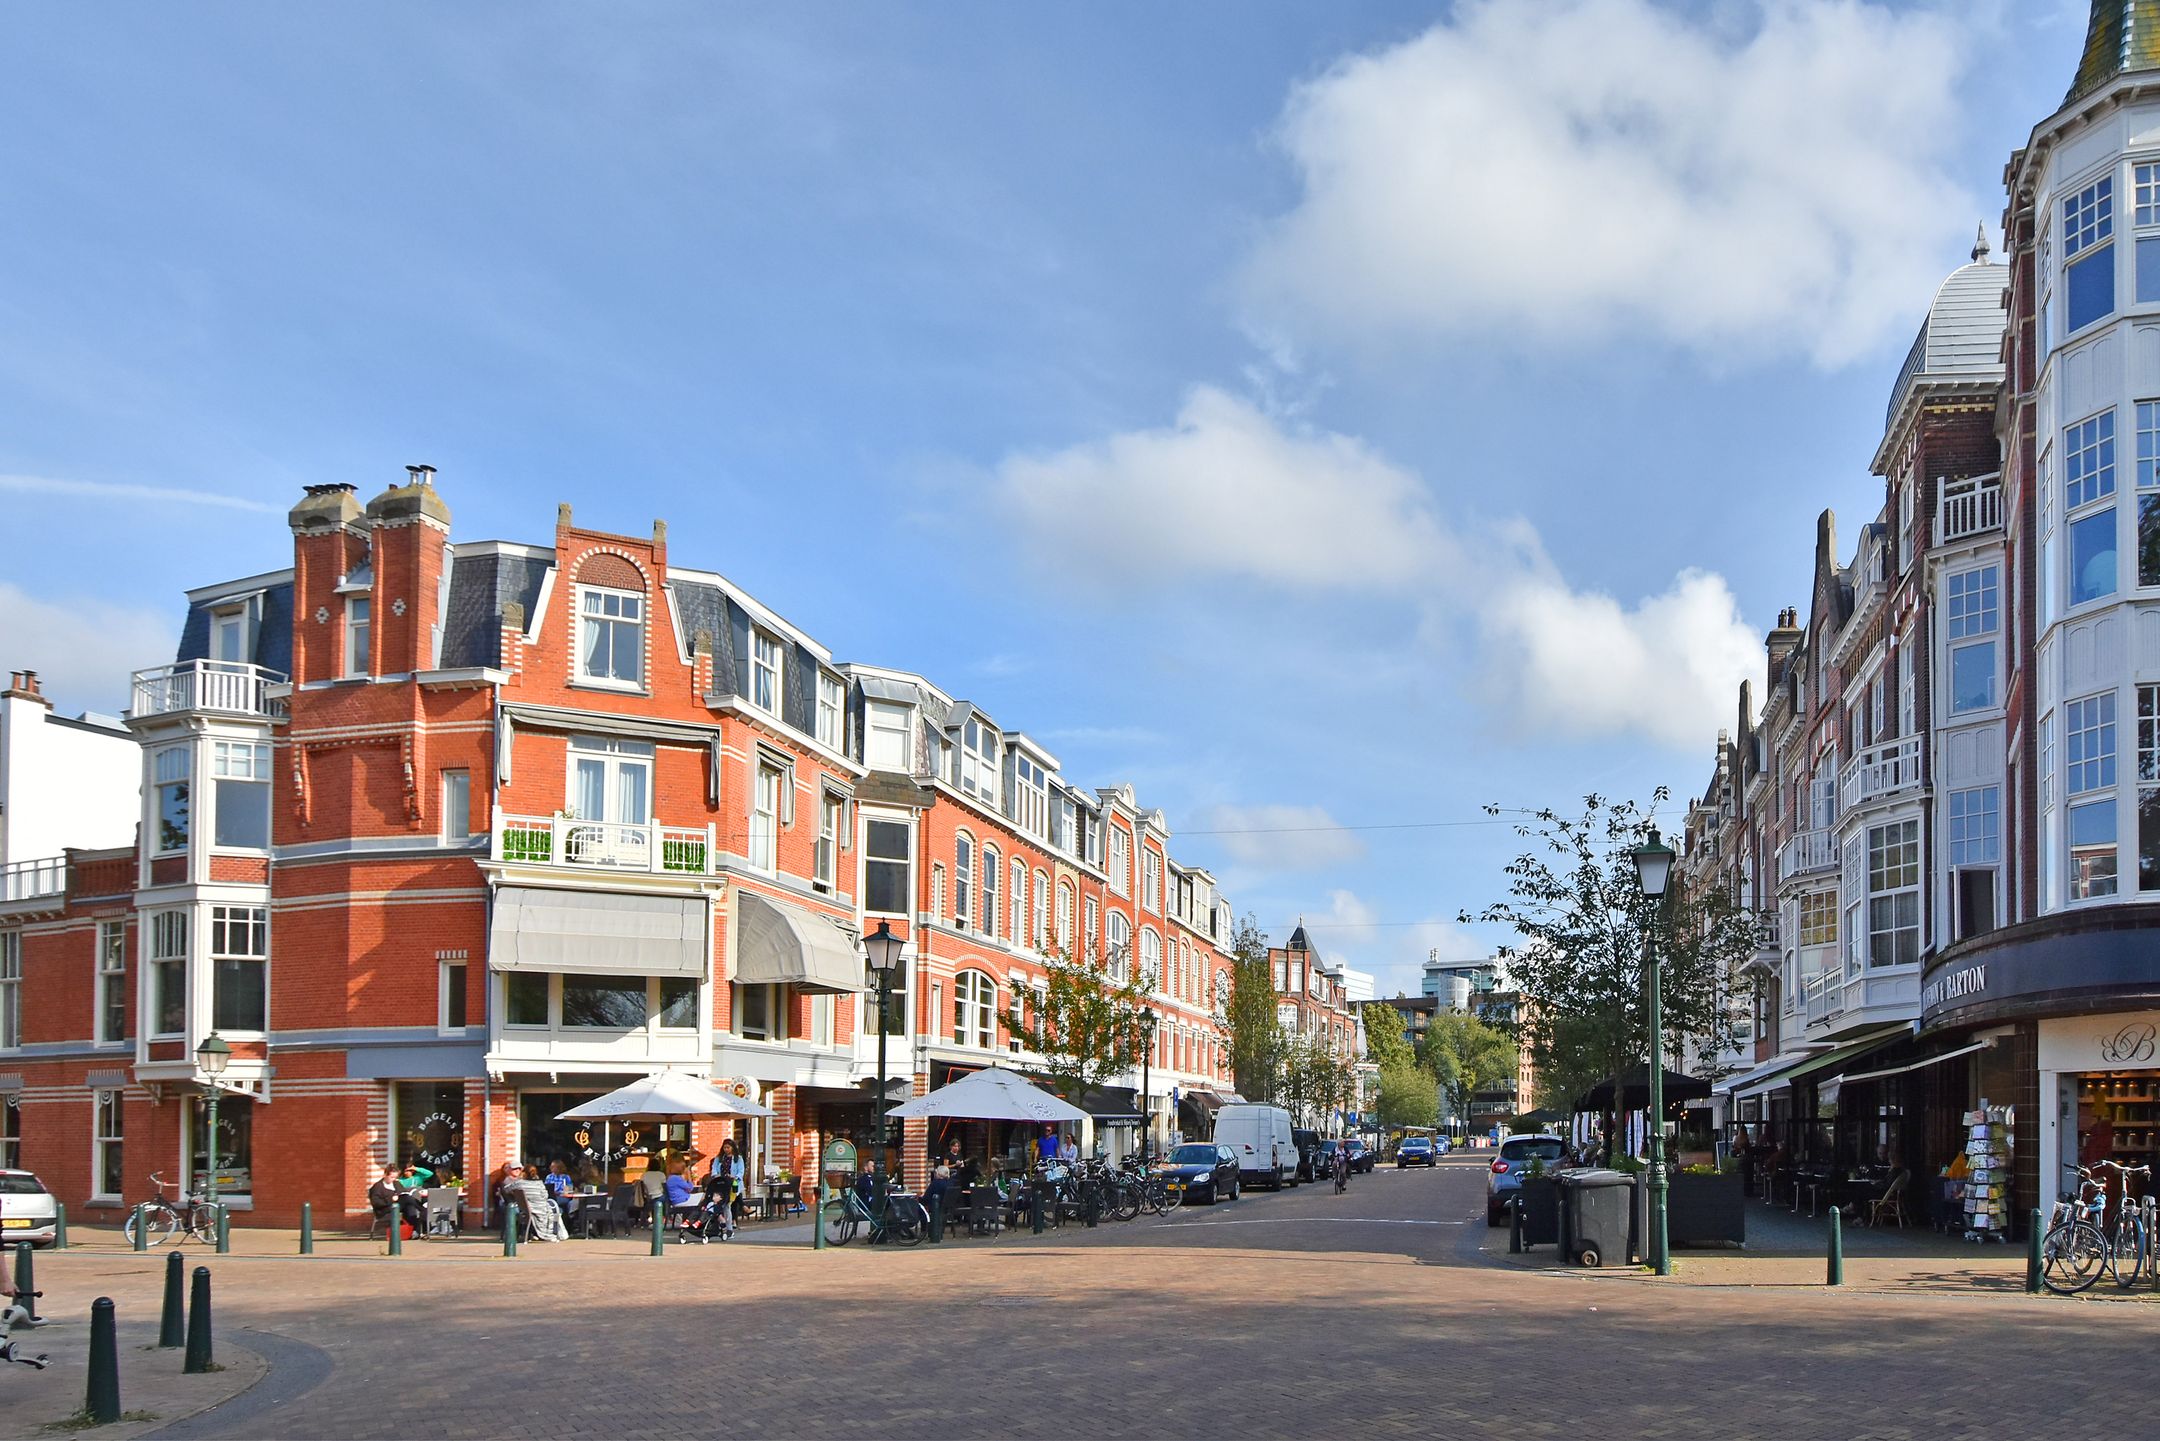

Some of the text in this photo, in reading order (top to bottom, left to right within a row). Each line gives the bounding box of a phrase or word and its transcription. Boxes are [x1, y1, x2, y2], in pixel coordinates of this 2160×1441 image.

[1946, 965, 1985, 1000] BARTON
[418, 1112, 457, 1131] BAGELS
[420, 1150, 455, 1165] BEANS
[583, 1147, 629, 1162] BEANS
